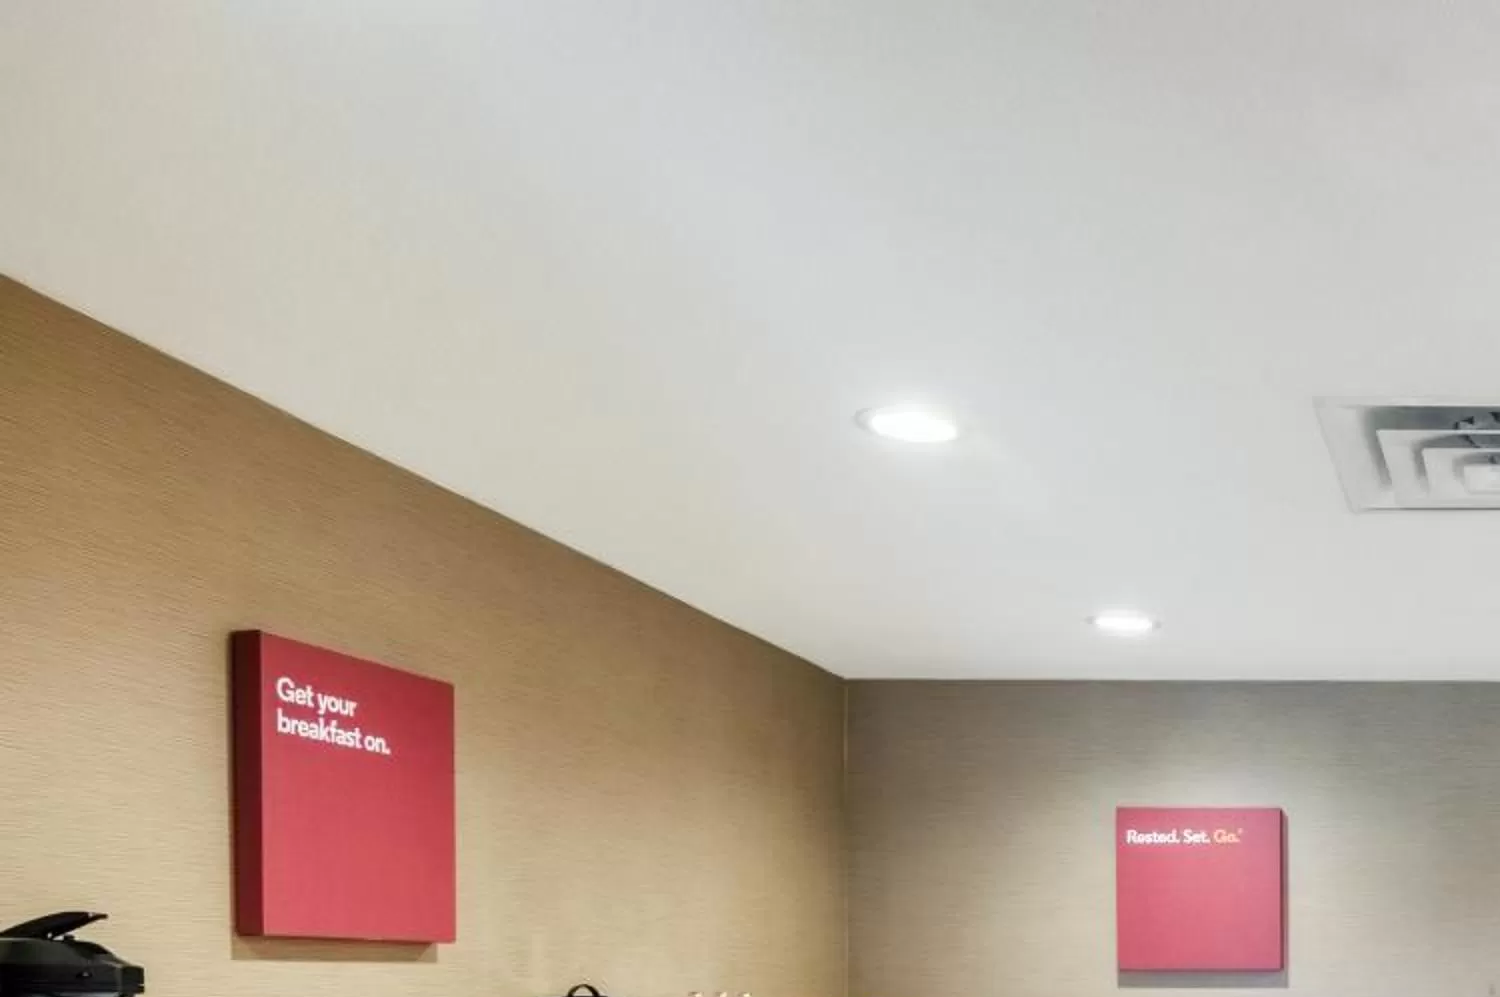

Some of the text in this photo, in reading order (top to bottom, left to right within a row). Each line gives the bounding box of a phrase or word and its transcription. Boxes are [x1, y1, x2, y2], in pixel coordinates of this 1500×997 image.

[276, 676, 358, 717] Get your
[277, 707, 391, 755] breakfast on.
[1126, 828, 1180, 844] Rested.
[1182, 829, 1211, 844] Set.
